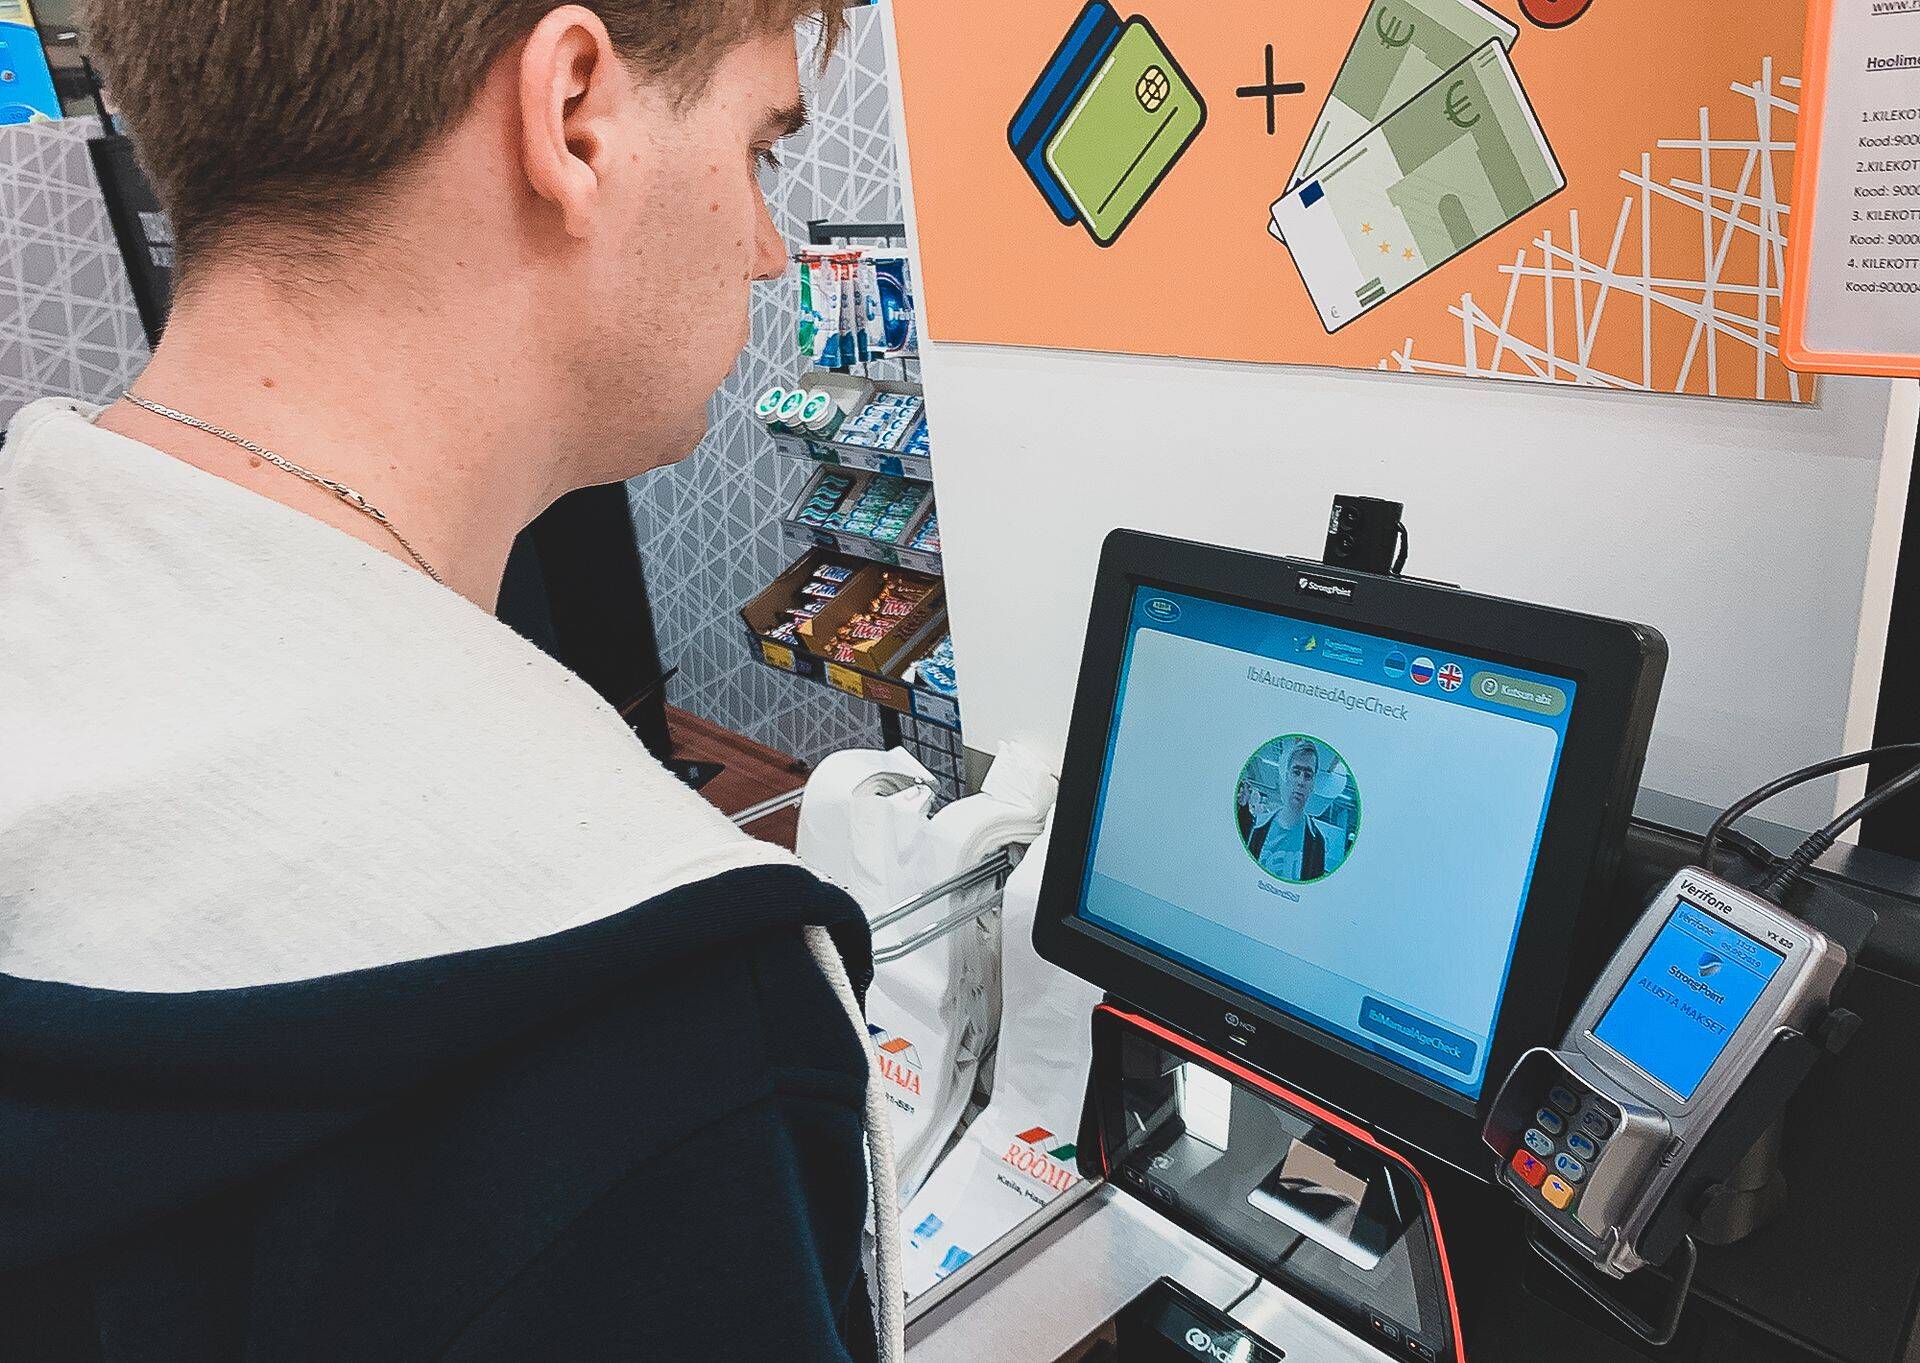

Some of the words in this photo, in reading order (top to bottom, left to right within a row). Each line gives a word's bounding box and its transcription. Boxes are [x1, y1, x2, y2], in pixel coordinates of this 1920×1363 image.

[1680, 878, 1733, 916] Verifone
[1667, 965, 1726, 1005] StrongPoint
[1638, 977, 1679, 1009] ALUSTA
[1680, 1002, 1728, 1036] MAKSET
